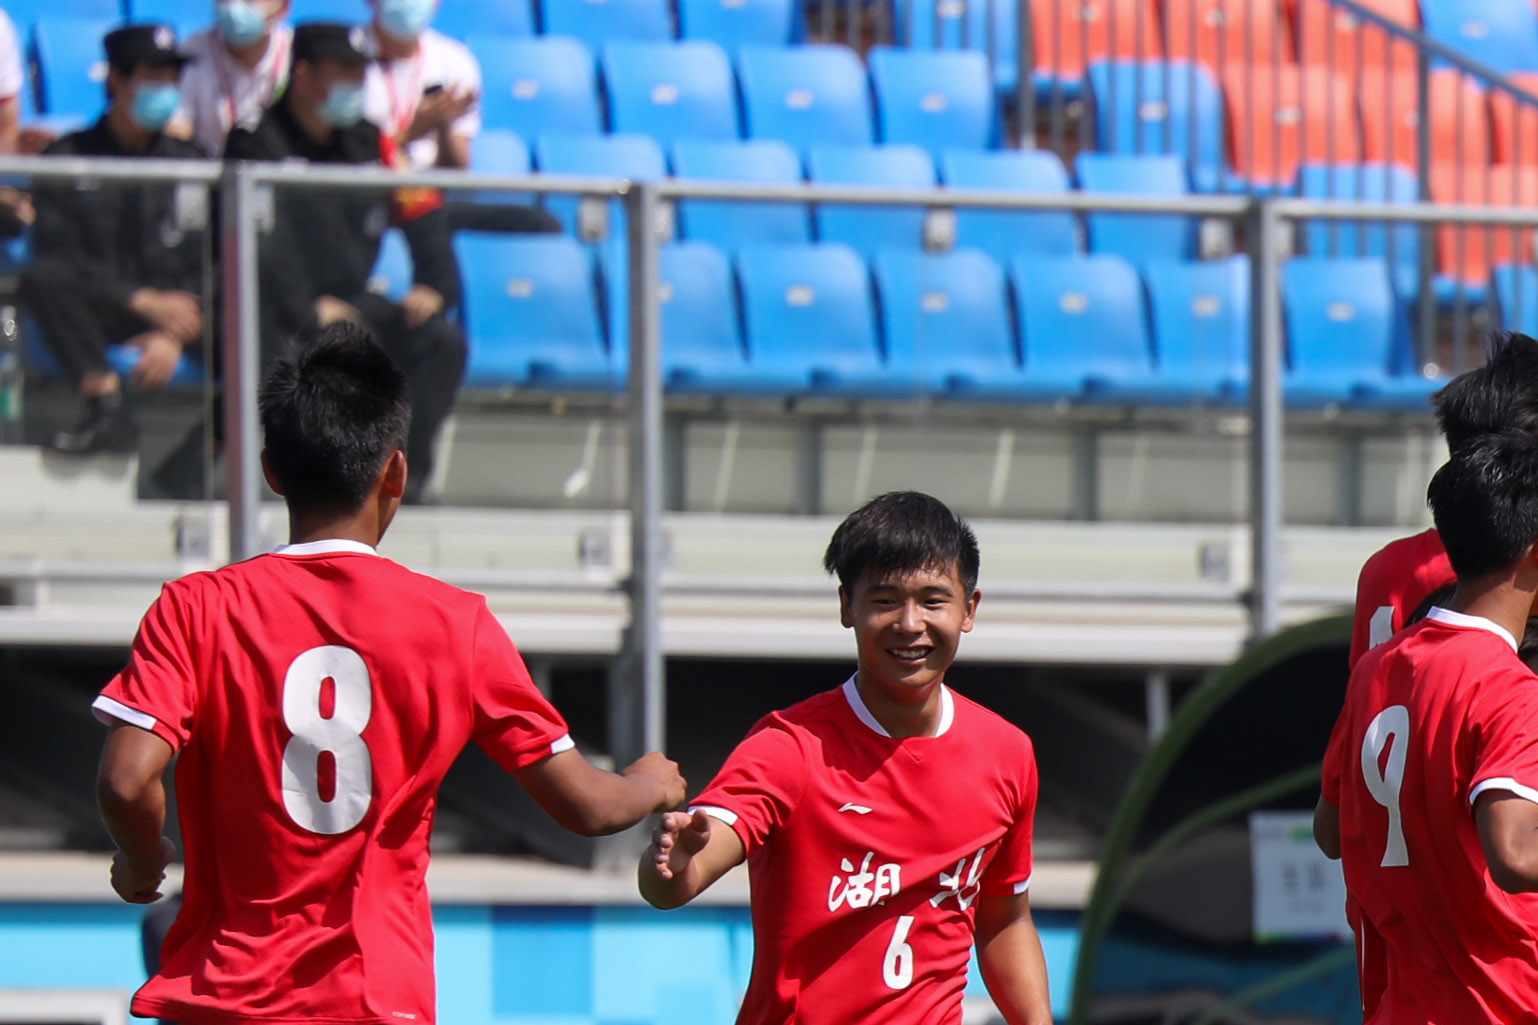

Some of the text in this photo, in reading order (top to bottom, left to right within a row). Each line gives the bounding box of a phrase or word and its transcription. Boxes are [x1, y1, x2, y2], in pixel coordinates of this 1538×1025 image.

[282, 645, 372, 834] 8
[1361, 705, 1410, 867] 9
[828, 848, 985, 912] 湖北
[883, 915, 915, 990] 6
